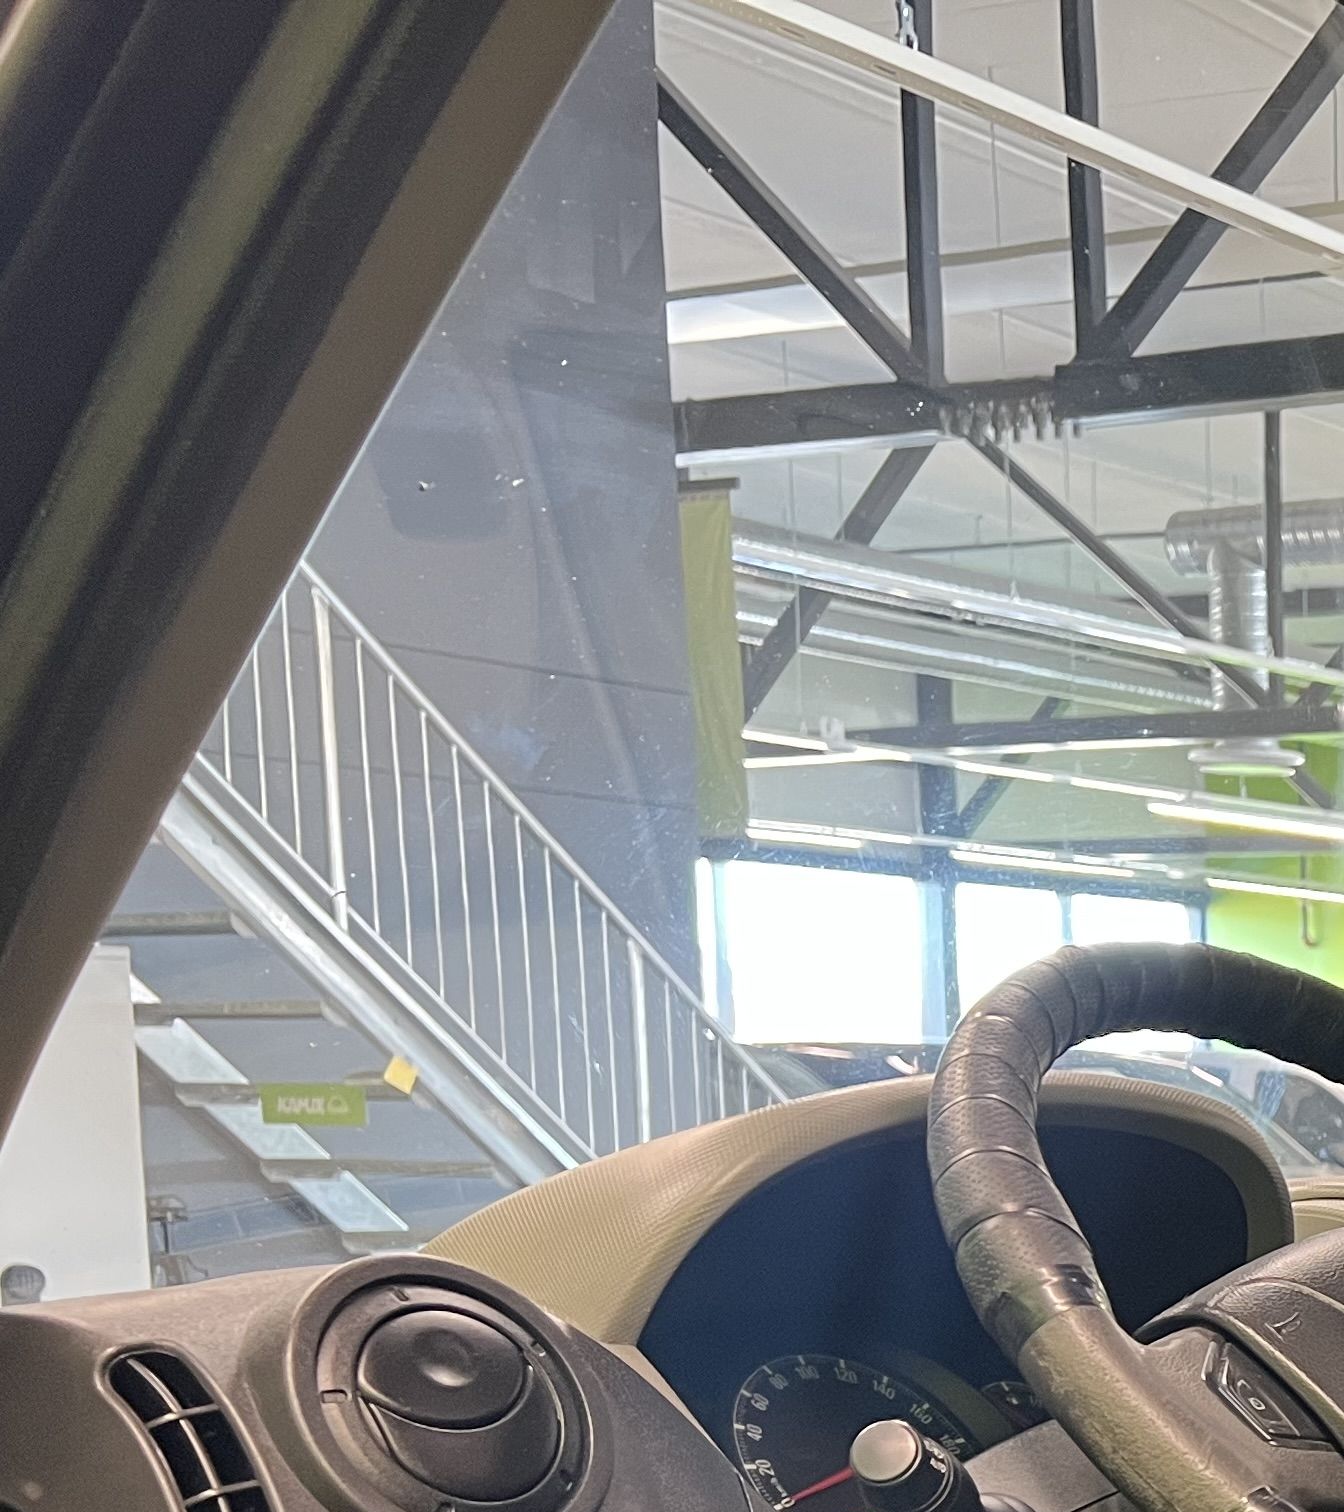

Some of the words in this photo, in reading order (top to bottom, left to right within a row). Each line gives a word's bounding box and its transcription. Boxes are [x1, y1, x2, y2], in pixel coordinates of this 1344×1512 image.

[834, 1366, 858, 1385] 120
[872, 1380, 896, 1400] 140
[750, 1393, 769, 1411] 60
[746, 1423, 763, 1441] 40
[755, 1459, 775, 1476] 20
